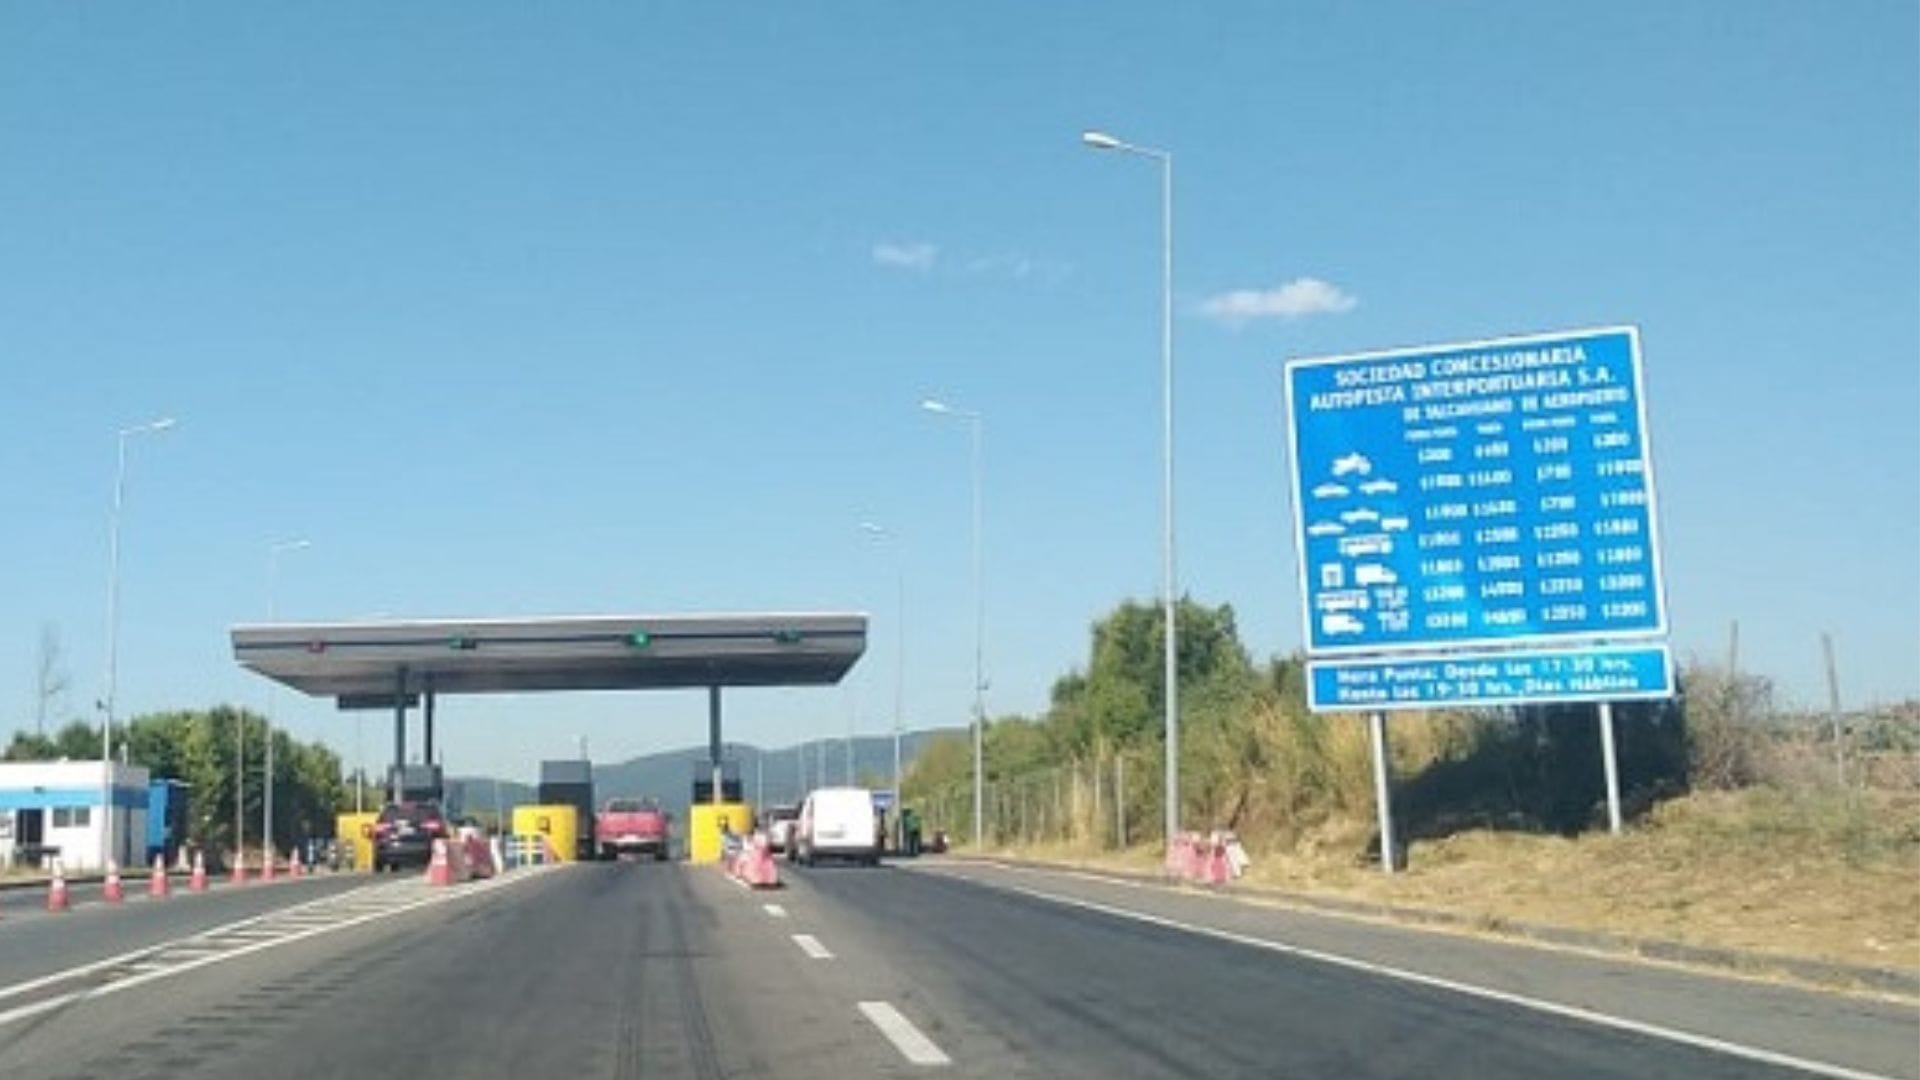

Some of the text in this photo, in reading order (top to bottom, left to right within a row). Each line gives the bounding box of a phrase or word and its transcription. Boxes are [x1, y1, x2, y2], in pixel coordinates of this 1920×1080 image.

[1310, 364, 1617, 411] AUTOPISTA INTERPORTUARIA S.A.
[1335, 347, 1587, 387] SOCIEDAD CONCESIONARIA
